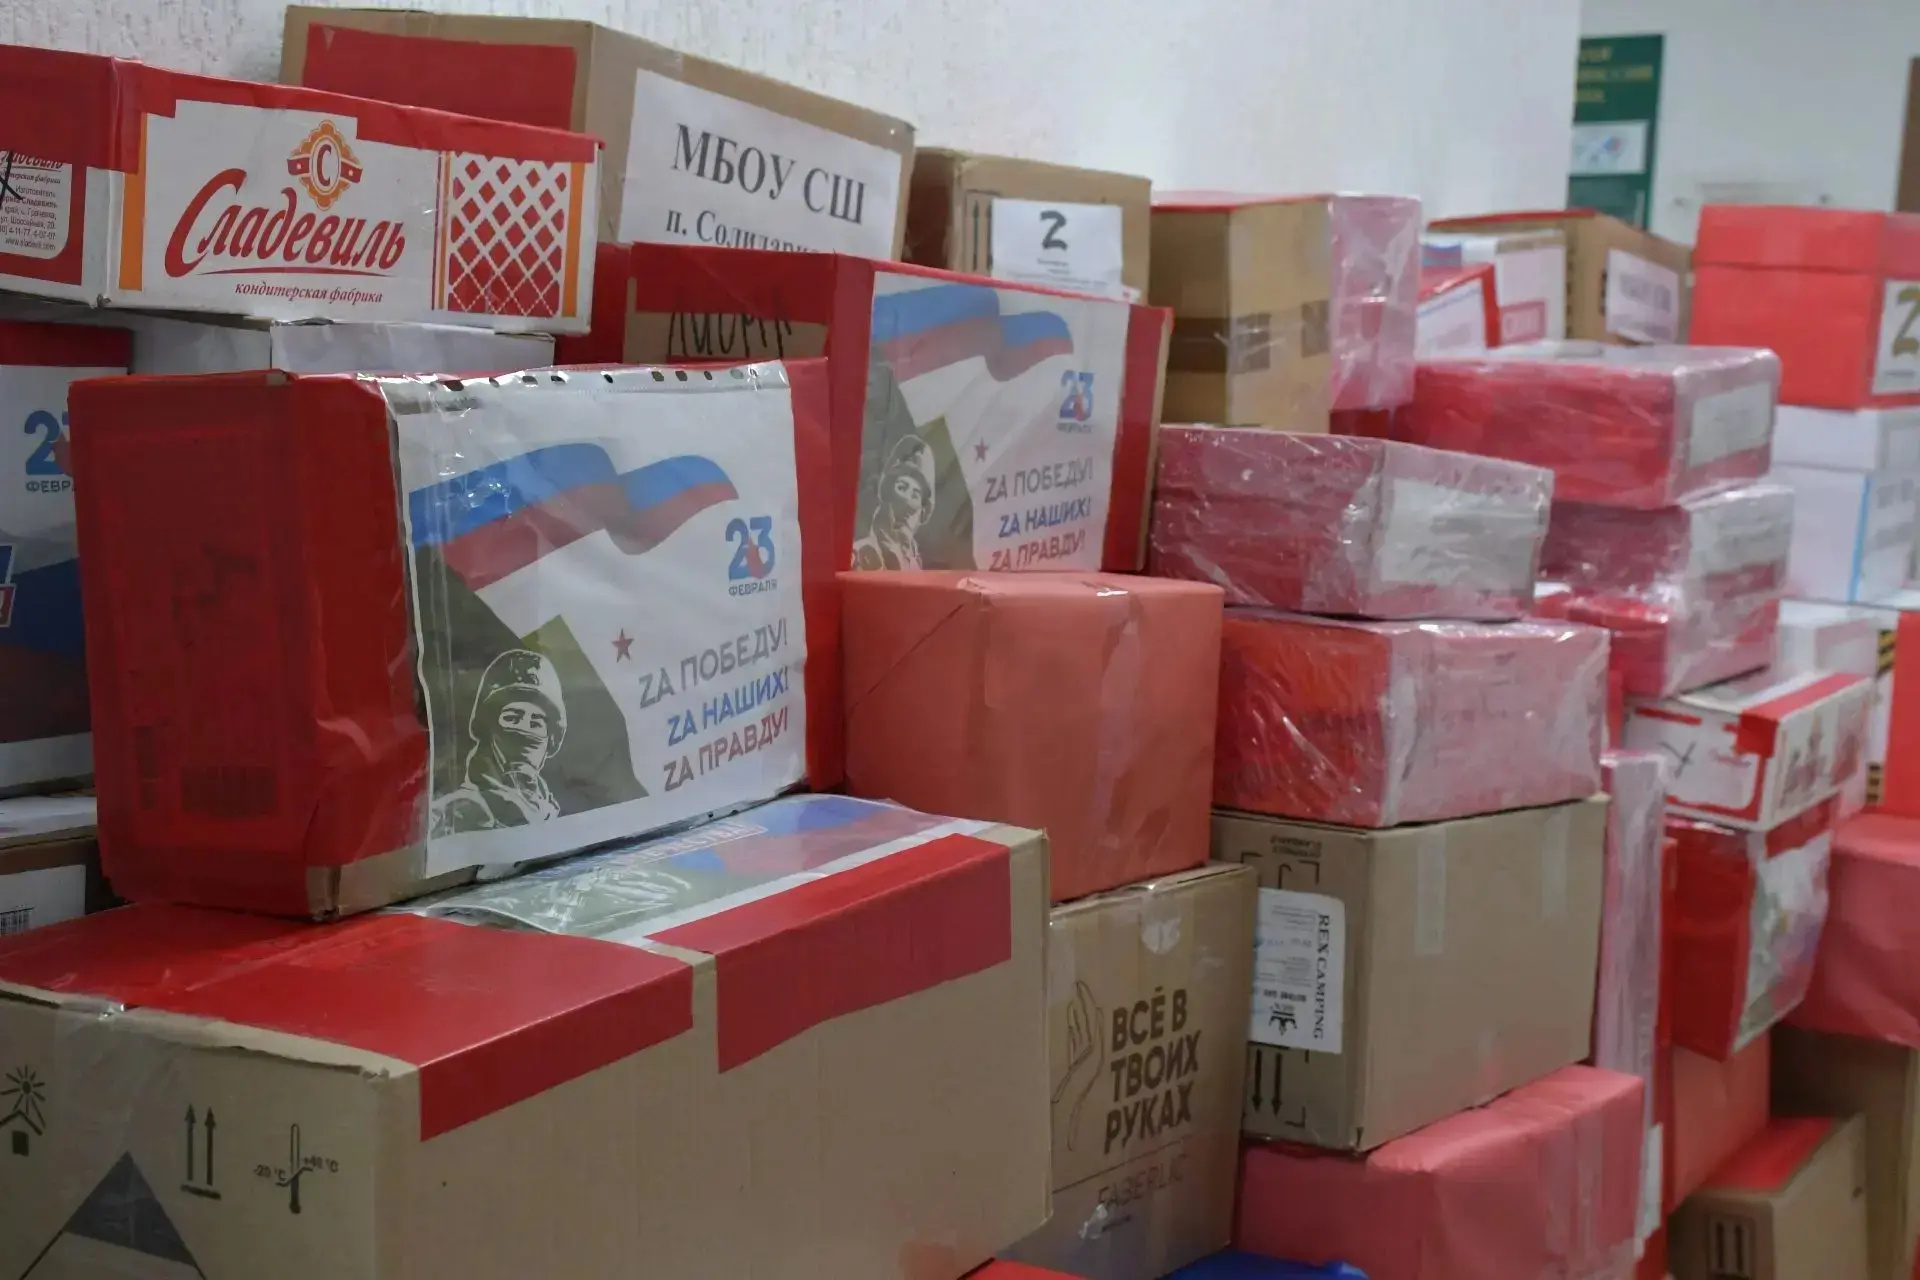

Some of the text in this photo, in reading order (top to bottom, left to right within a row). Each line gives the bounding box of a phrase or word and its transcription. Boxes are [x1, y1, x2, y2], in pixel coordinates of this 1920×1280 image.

[670, 123, 866, 224] МБОУ СШ
[164, 168, 406, 278] Сладевиль
[665, 209, 688, 236] п.
[235, 281, 384, 306] кондитерская фабрика
[1059, 369, 1096, 422] 23
[24, 410, 71, 476] 2
[25, 480, 76, 493] ФЕВР
[984, 456, 1094, 504] ZA ПОБЕДУ!
[725, 514, 777, 581] 23
[988, 528, 1086, 572] ZA ПРАВДУ!
[998, 495, 1091, 538] ZA НАШИХ!
[727, 578, 778, 597] ФЕВРАЛЯ
[638, 617, 788, 709] ZA ПОБЕДУ!
[667, 666, 790, 747] ZA НАШИХ!
[663, 705, 789, 793] ZA ПРАВДУ!
[1312, 913, 1331, 1040] REX CAMPING
[1111, 985, 1188, 1052] ВСЁ В
[1110, 1029, 1202, 1103] ТВОИХ
[1103, 1080, 1194, 1156] РУКАХ
